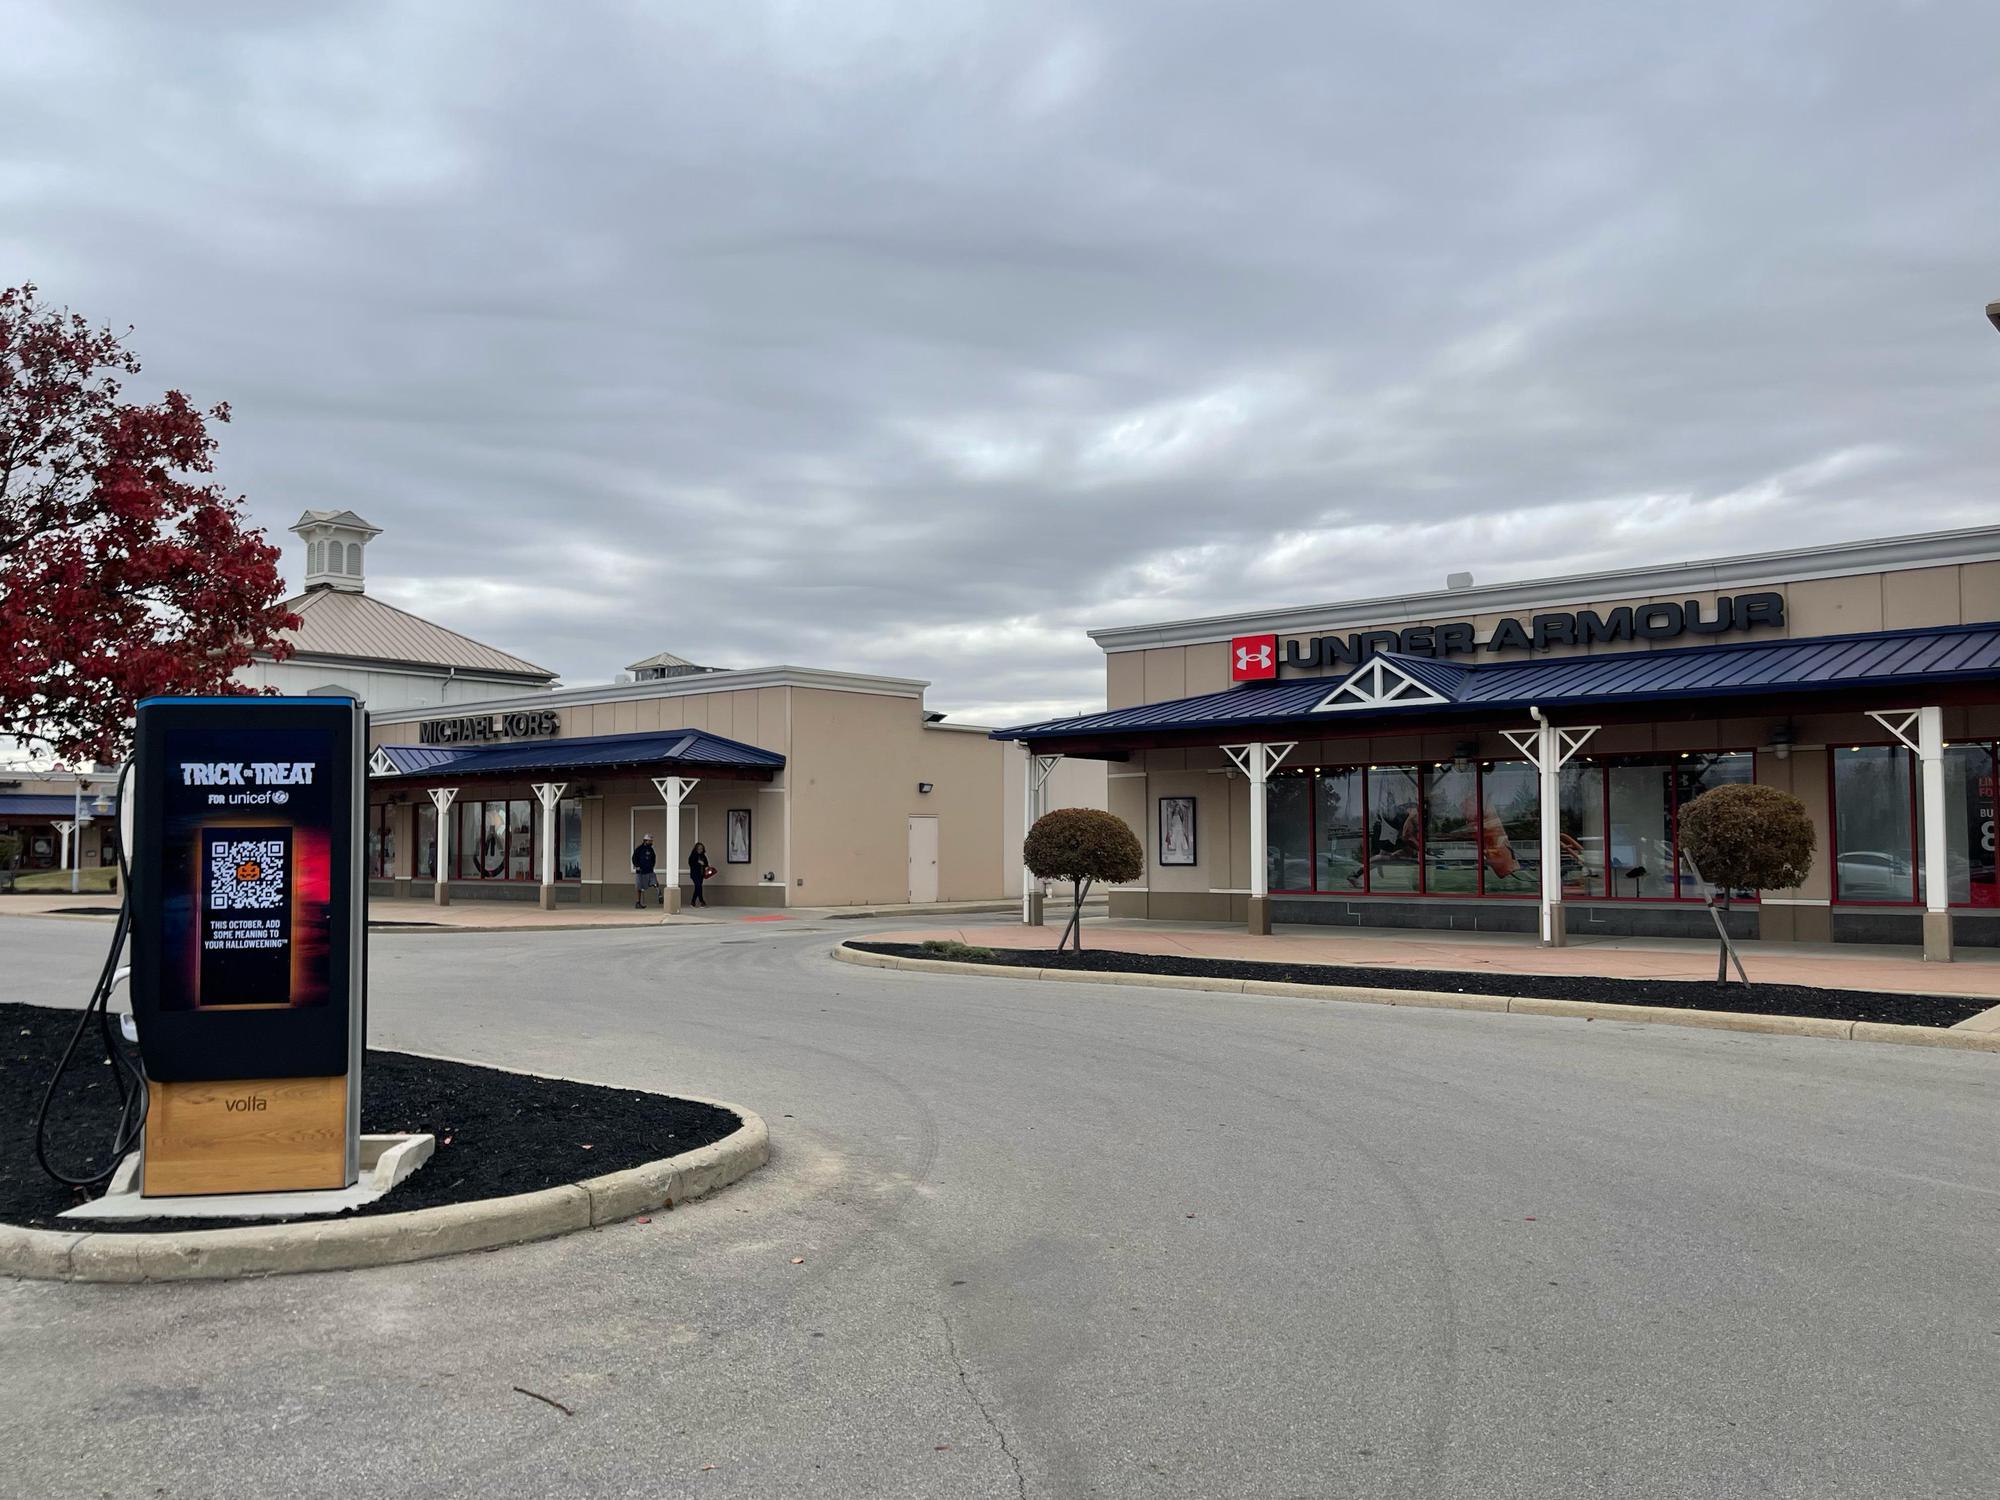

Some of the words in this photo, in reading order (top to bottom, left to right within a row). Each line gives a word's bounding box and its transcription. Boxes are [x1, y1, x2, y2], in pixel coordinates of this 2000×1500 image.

[1287, 623, 1476, 668] UNDER
[1486, 592, 1784, 652] ARMOUR
[419, 717, 493, 744] MICHAEL
[502, 710, 560, 737] KORS
[180, 763, 245, 785] TRICK
[251, 762, 315, 785] TREAT
[208, 795, 225, 804] FOR
[229, 791, 271, 804] unicef
[1980, 808, 1994, 818] BU
[210, 921, 227, 930] THIS
[228, 920, 264, 929] OCTOBER,
[265, 920, 280, 928] ADD
[213, 930, 233, 939] SOME
[235, 930, 268, 938] MEANING
[269, 930, 279, 938] TO
[204, 941, 224, 949] YOUR
